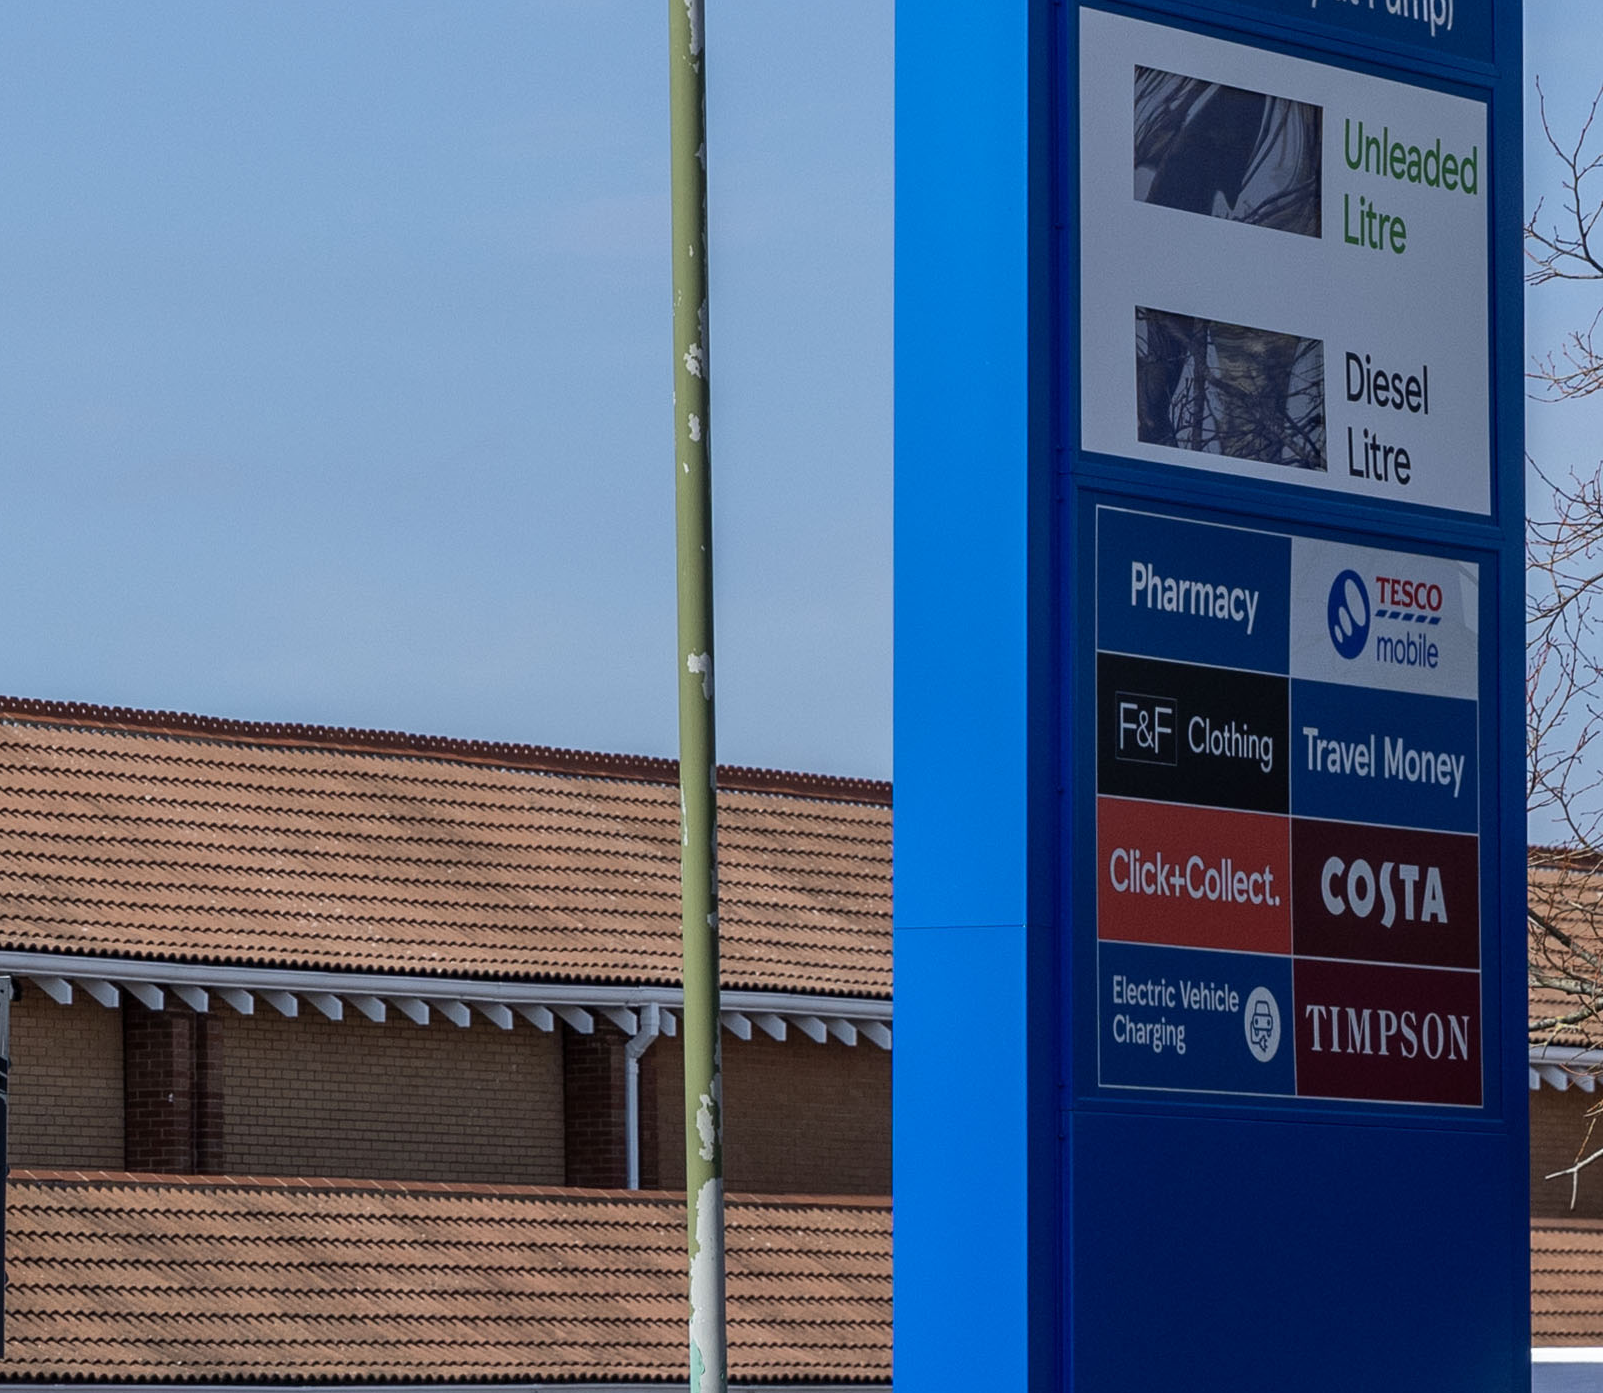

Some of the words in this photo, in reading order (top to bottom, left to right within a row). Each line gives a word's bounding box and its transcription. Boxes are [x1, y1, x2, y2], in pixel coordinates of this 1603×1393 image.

[1345, 118, 1478, 195] Unleaded
[1344, 193, 1407, 255] Litre
[1345, 351, 1430, 416] Diesel
[1347, 426, 1412, 486] Litre
[1131, 561, 1259, 635] Pharmacy
[1375, 576, 1442, 613] TESCO
[1376, 632, 1439, 669] mobile
[1119, 701, 1173, 754] F&F
[1188, 715, 1273, 774] Clothing
[1302, 726, 1376, 778] Travel
[1383, 736, 1465, 799] Money
[1109, 847, 1280, 907] Click+Collect.
[1320, 856, 1448, 929] COSTA
[1113, 975, 1176, 1009] Electric
[1179, 979, 1240, 1013] Vehicle
[1113, 1014, 1186, 1055] Charging
[1305, 1004, 1470, 1061] TIMPSON
